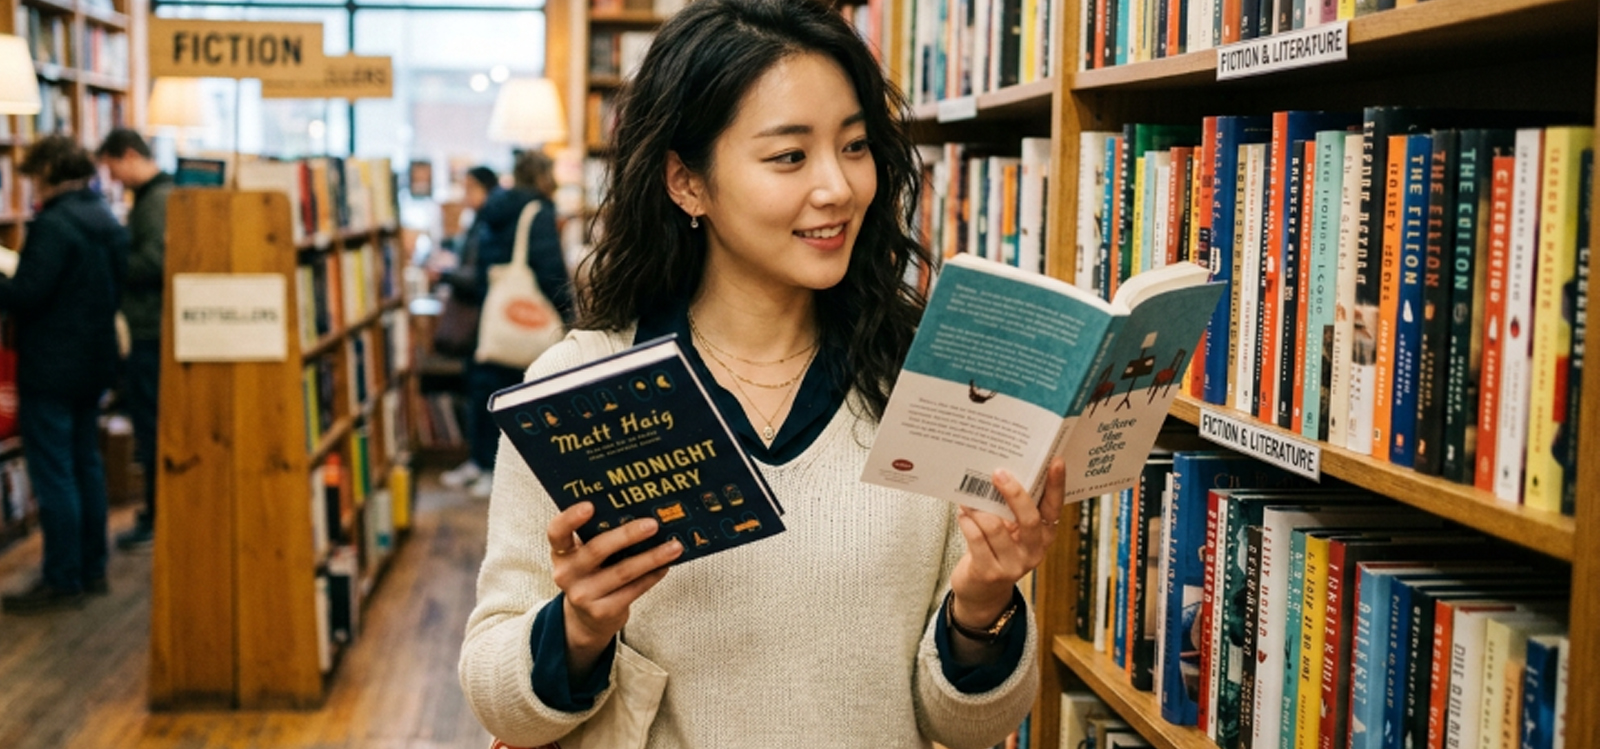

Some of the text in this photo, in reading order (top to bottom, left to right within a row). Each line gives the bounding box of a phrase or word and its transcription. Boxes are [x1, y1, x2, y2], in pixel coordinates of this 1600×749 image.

[172, 31, 302, 65] FICTION
[1220, 29, 1342, 72] FICTION & LITERATURE
[1410, 155, 1424, 195] THE
[1430, 150, 1446, 195] THE
[1459, 148, 1476, 193] THE
[551, 424, 611, 454] Matt
[620, 410, 674, 435] Haig
[1203, 414, 1315, 472] FICTION & LITERATURE
[563, 479, 604, 499] The
[606, 439, 716, 486] MIDNIGHT
[608, 469, 702, 509] LIBRARY
